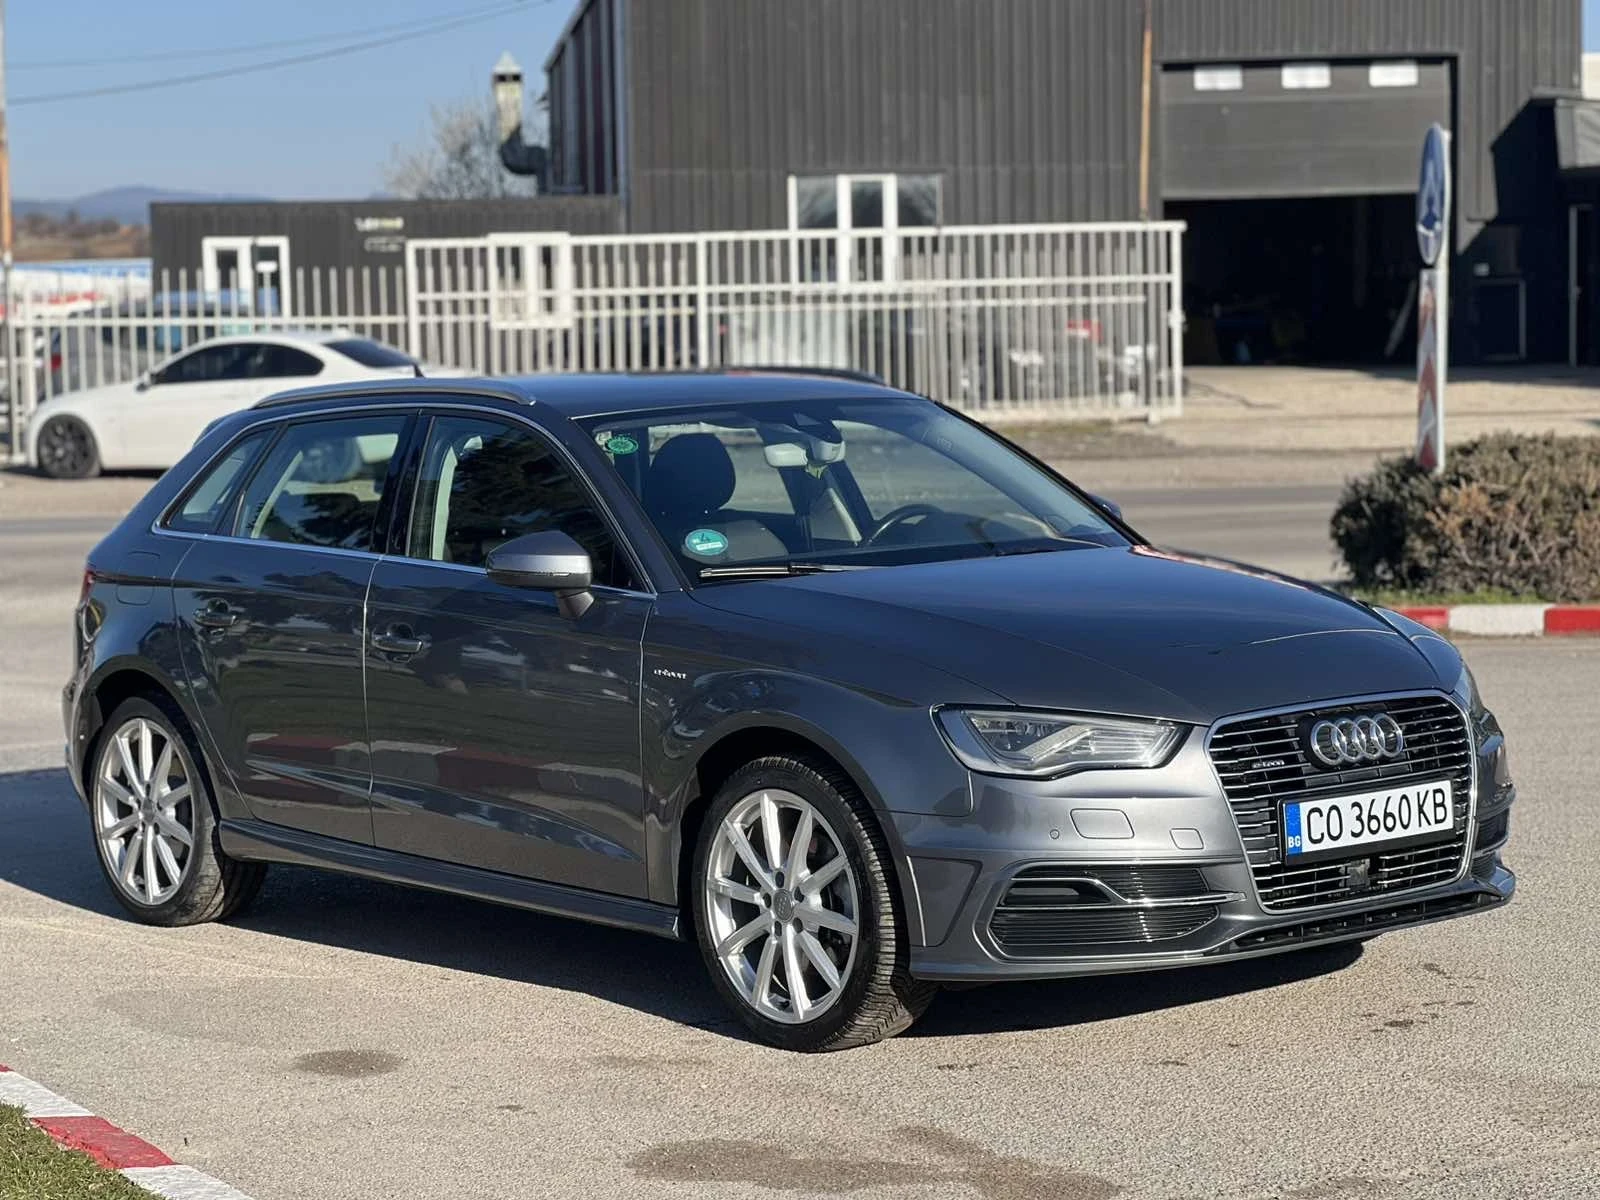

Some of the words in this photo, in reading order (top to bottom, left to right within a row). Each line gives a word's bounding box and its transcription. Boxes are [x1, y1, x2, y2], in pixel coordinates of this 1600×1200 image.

[1307, 804, 1343, 844] CO
[1350, 793, 1411, 838] 3660
[1417, 788, 1447, 827] KB
[1288, 836, 1301, 848] BG
